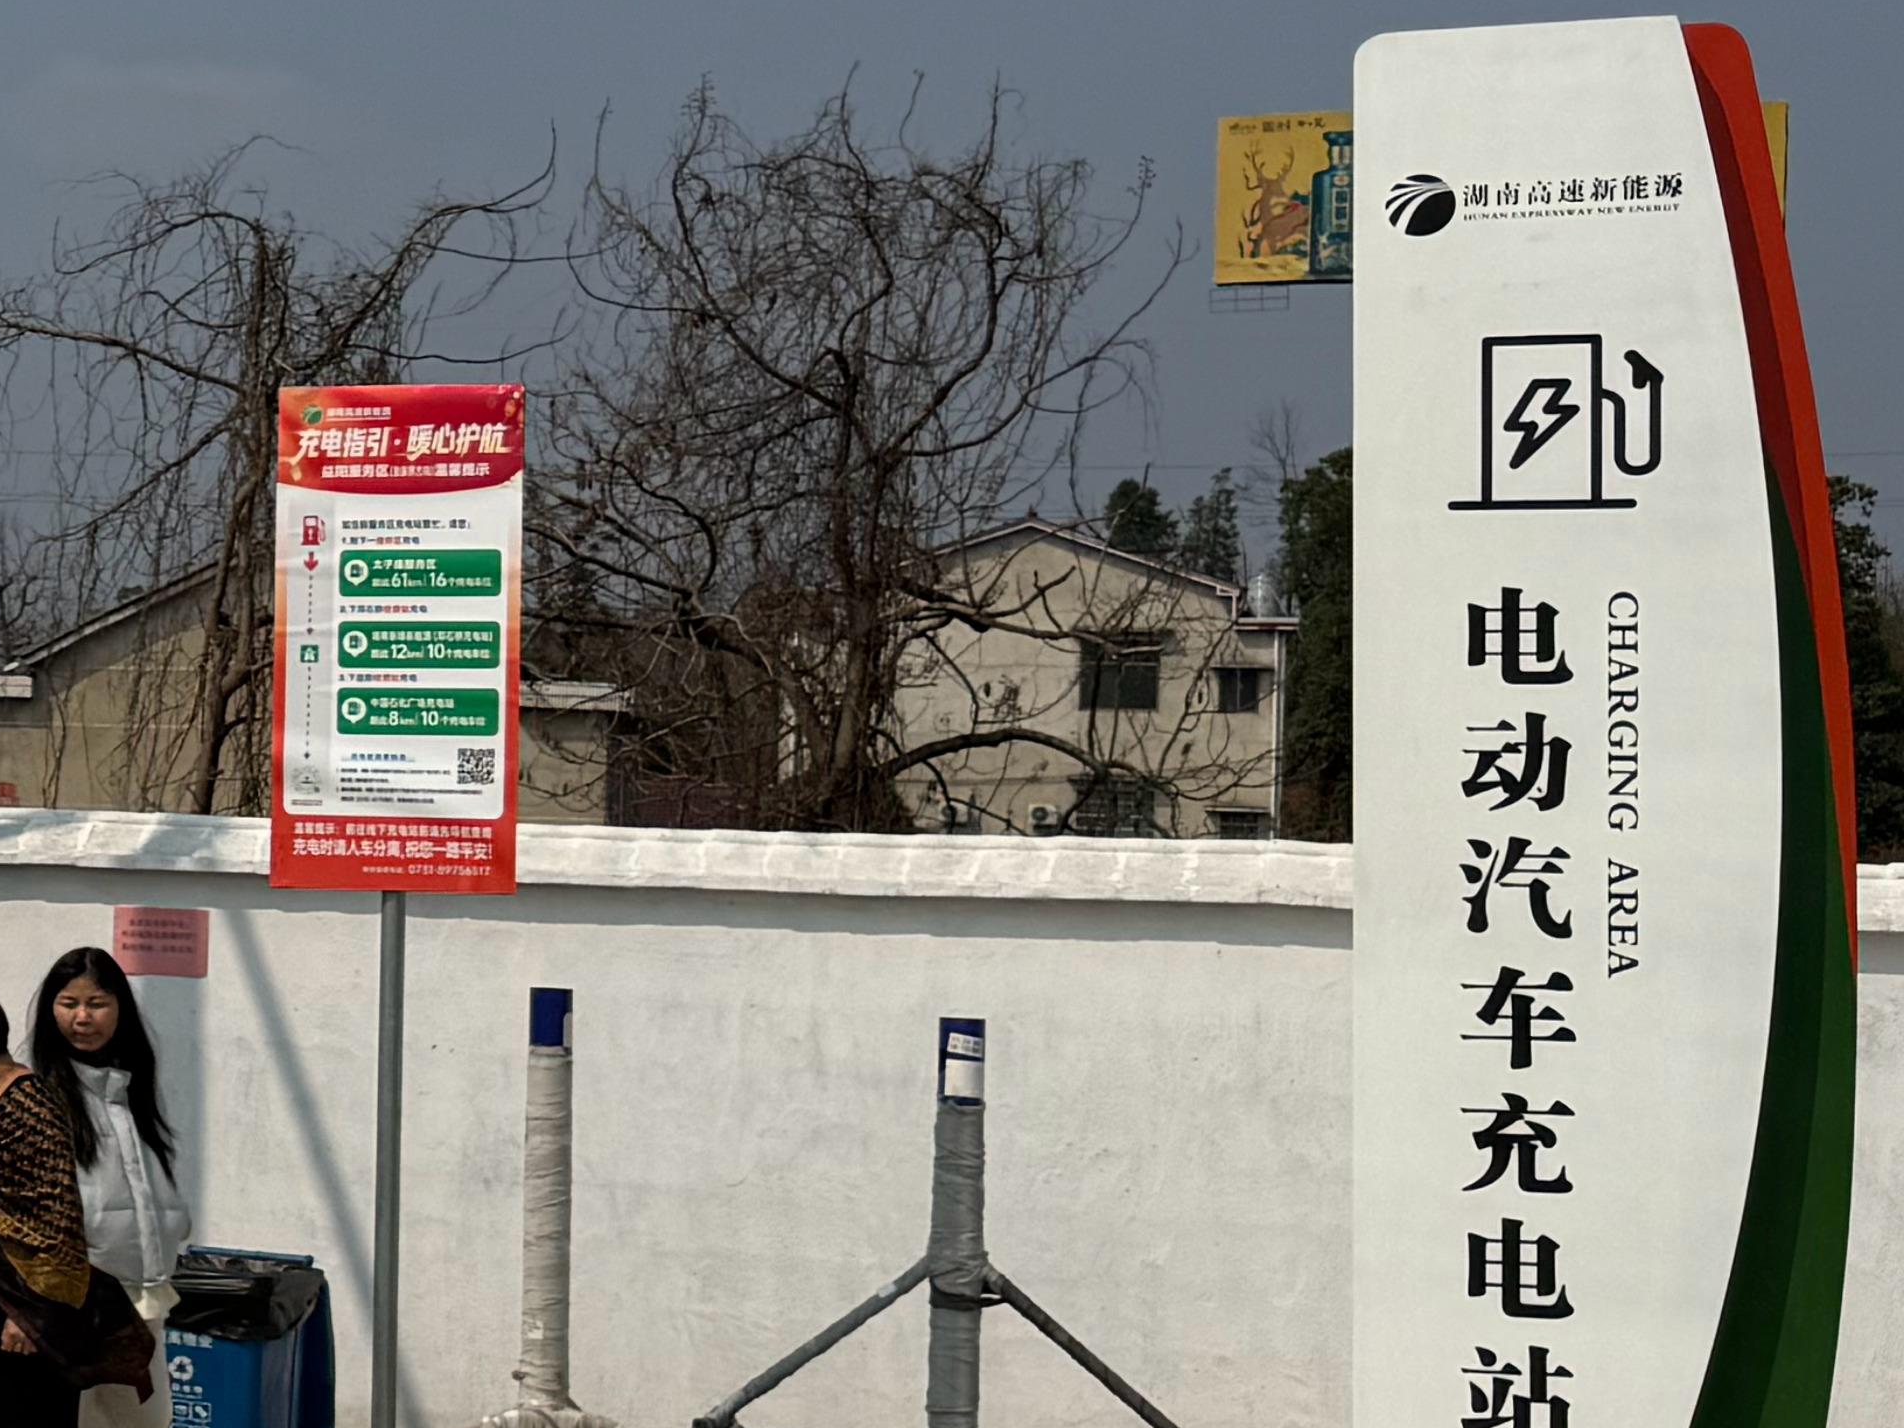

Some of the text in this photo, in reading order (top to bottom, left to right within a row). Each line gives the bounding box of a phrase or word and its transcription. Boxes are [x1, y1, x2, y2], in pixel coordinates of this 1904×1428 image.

[1463, 172, 1683, 207] 湖南高速新能源
[1607, 591, 1640, 979] CHARGING AREA
